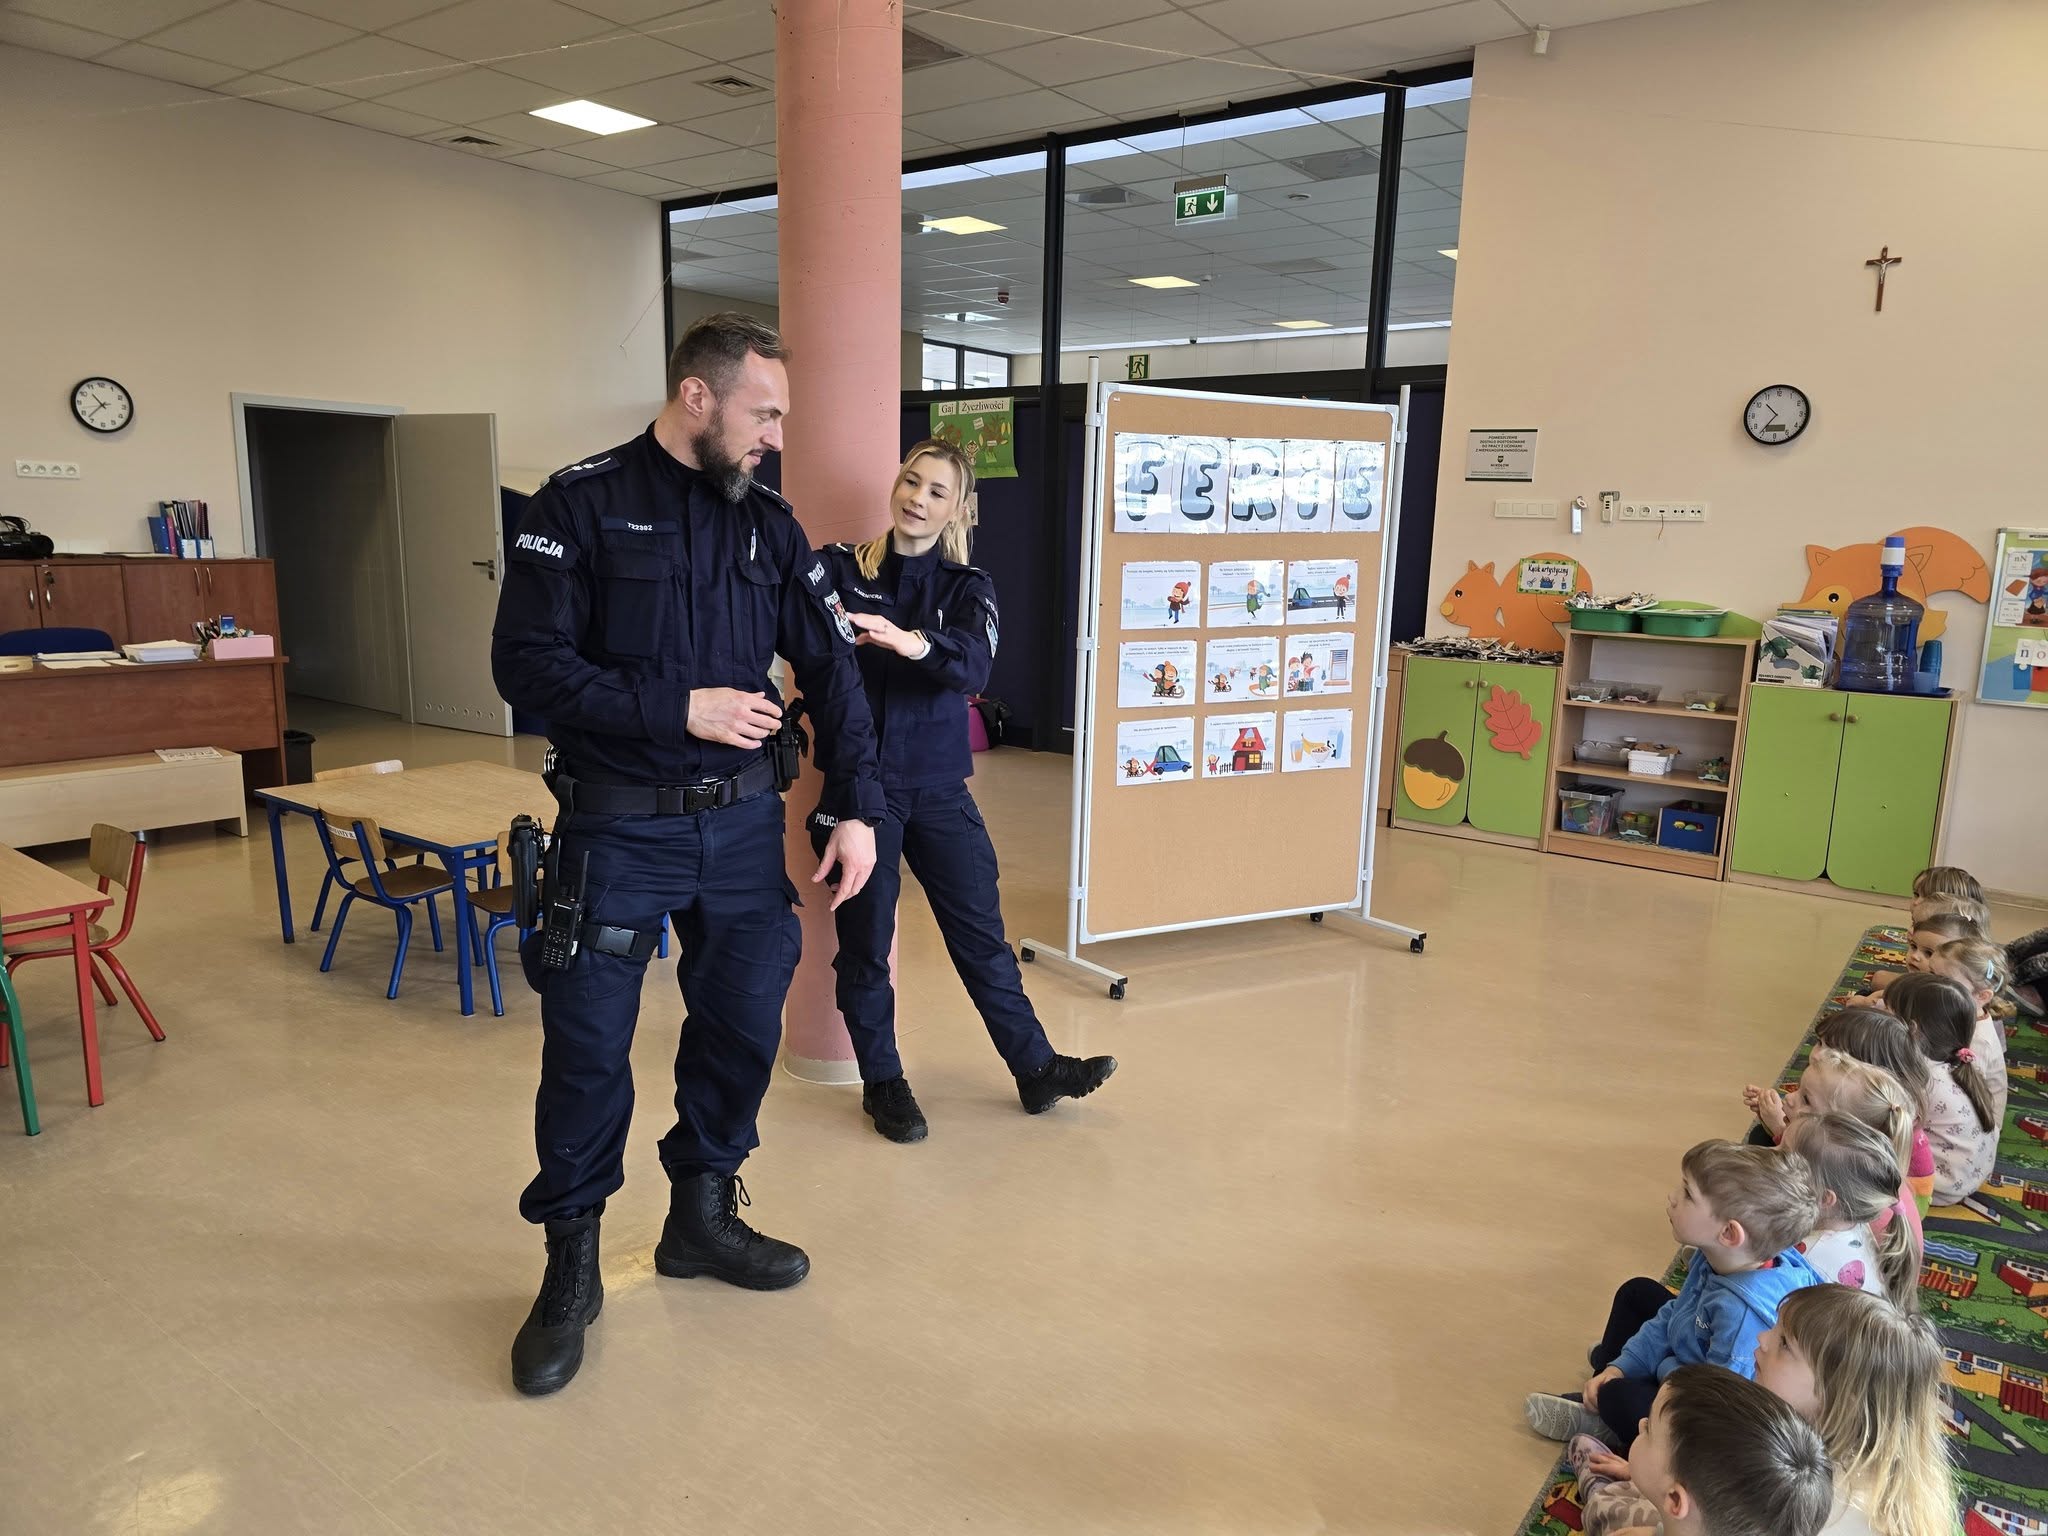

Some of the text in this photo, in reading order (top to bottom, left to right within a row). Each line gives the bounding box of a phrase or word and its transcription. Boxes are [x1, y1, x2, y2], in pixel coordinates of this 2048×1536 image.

[941, 400, 1004, 413] Gaj Życzliwości
[515, 533, 564, 559] POLICJA
[2020, 648, 2029, 658] n
[815, 812, 839, 828] POLICJ
